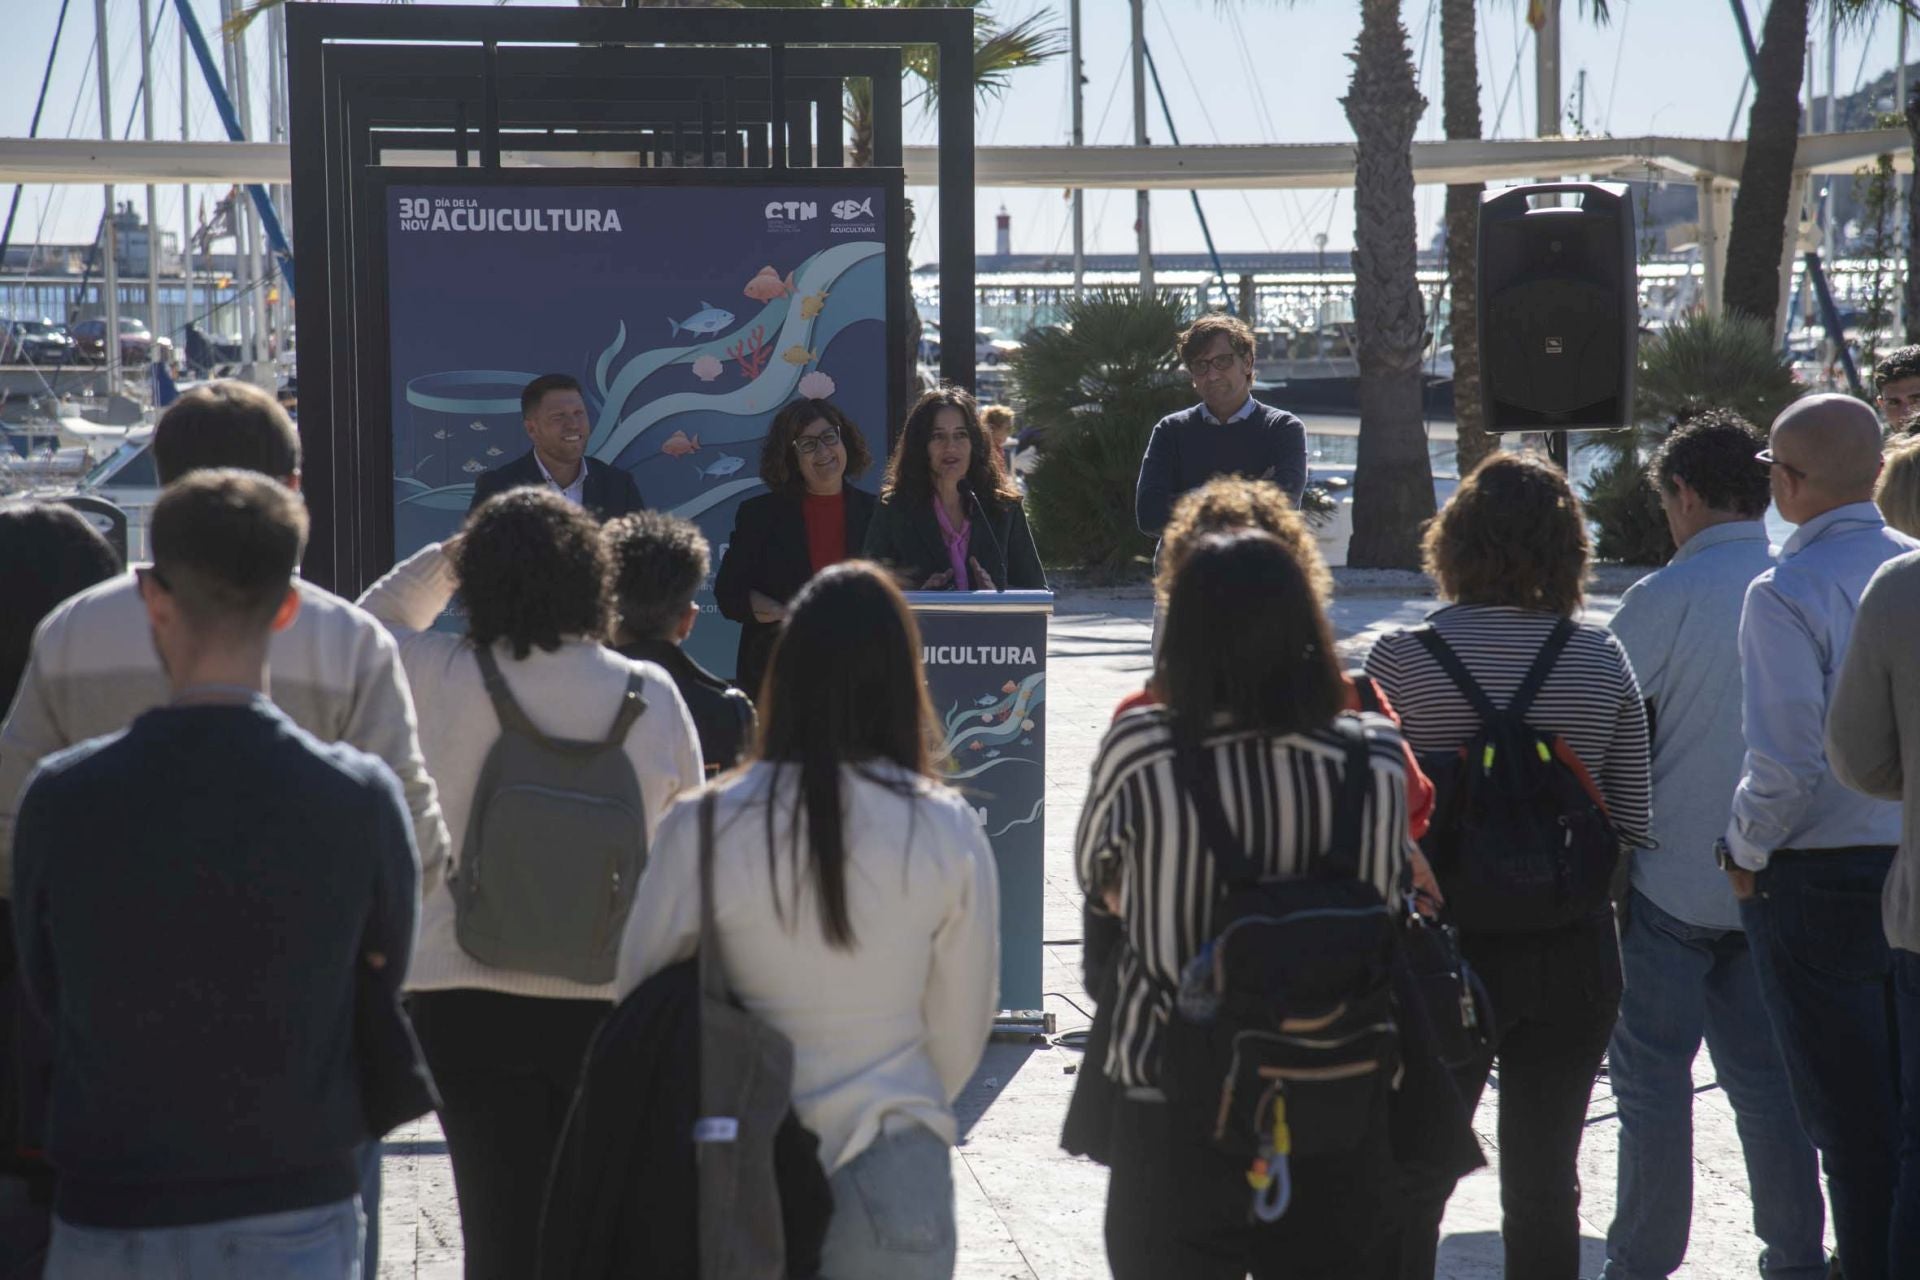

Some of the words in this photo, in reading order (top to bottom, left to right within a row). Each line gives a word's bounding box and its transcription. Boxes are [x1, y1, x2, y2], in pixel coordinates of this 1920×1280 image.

[399, 198, 430, 219] 30
[435, 197, 451, 207] DÍA
[453, 199, 465, 207] DE
[466, 199, 478, 207] LA
[764, 201, 818, 221] CTN
[830, 196, 875, 220] SEA
[400, 219, 430, 231] NOV
[431, 209, 622, 231] ACUICULTURA
